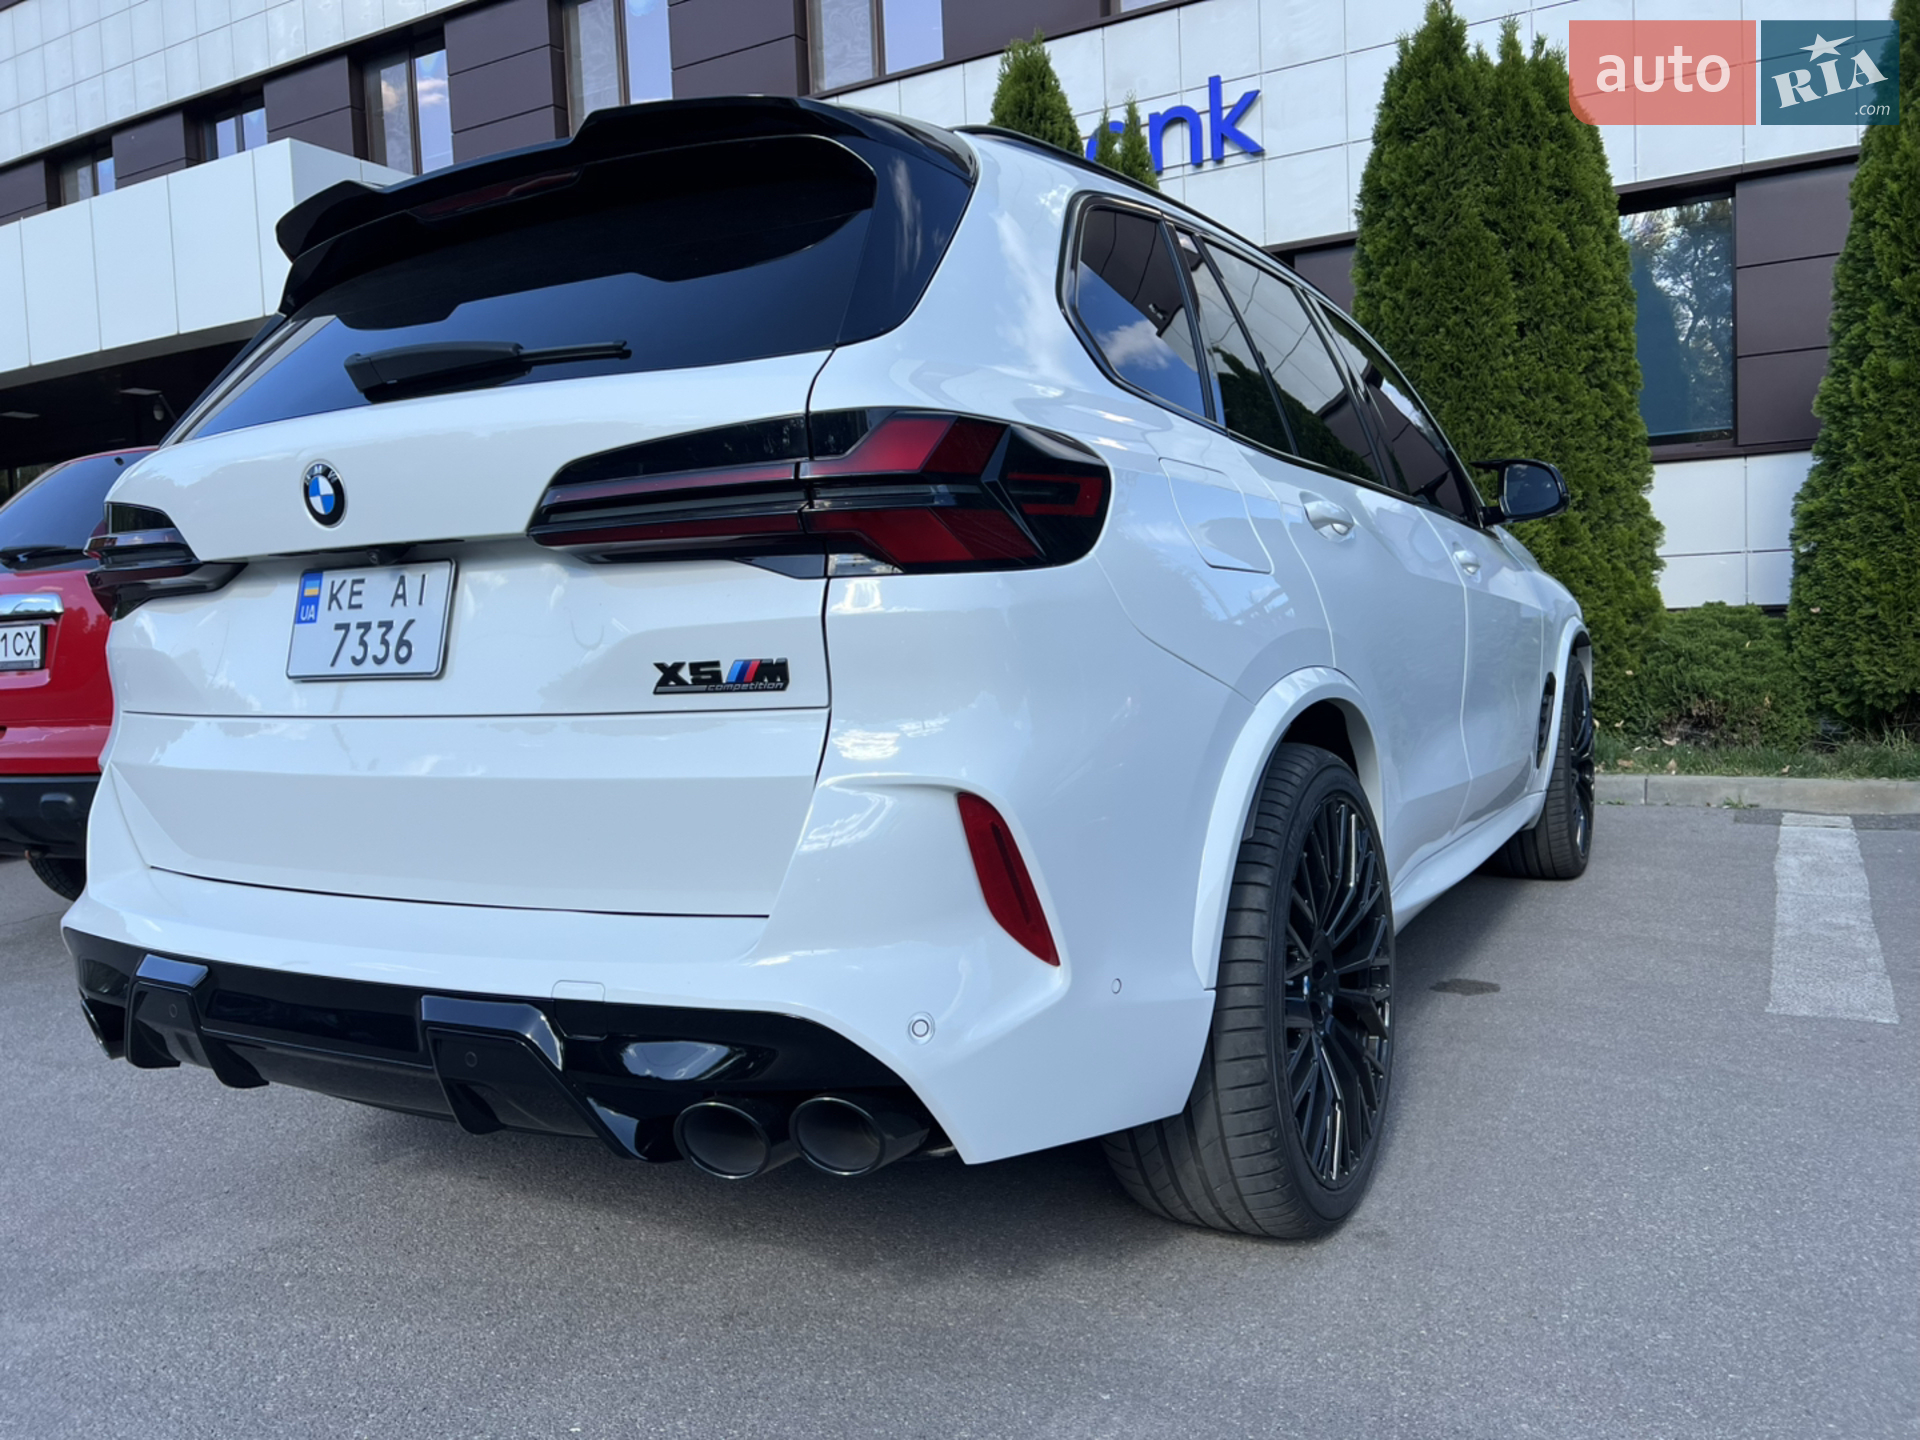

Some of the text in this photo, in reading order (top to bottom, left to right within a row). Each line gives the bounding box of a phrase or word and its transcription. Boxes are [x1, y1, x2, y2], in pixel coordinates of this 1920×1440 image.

[327, 573, 427, 612] KE AI
[300, 604, 316, 622] UA
[330, 618, 416, 668] 7336
[706, 681, 785, 692] competition
